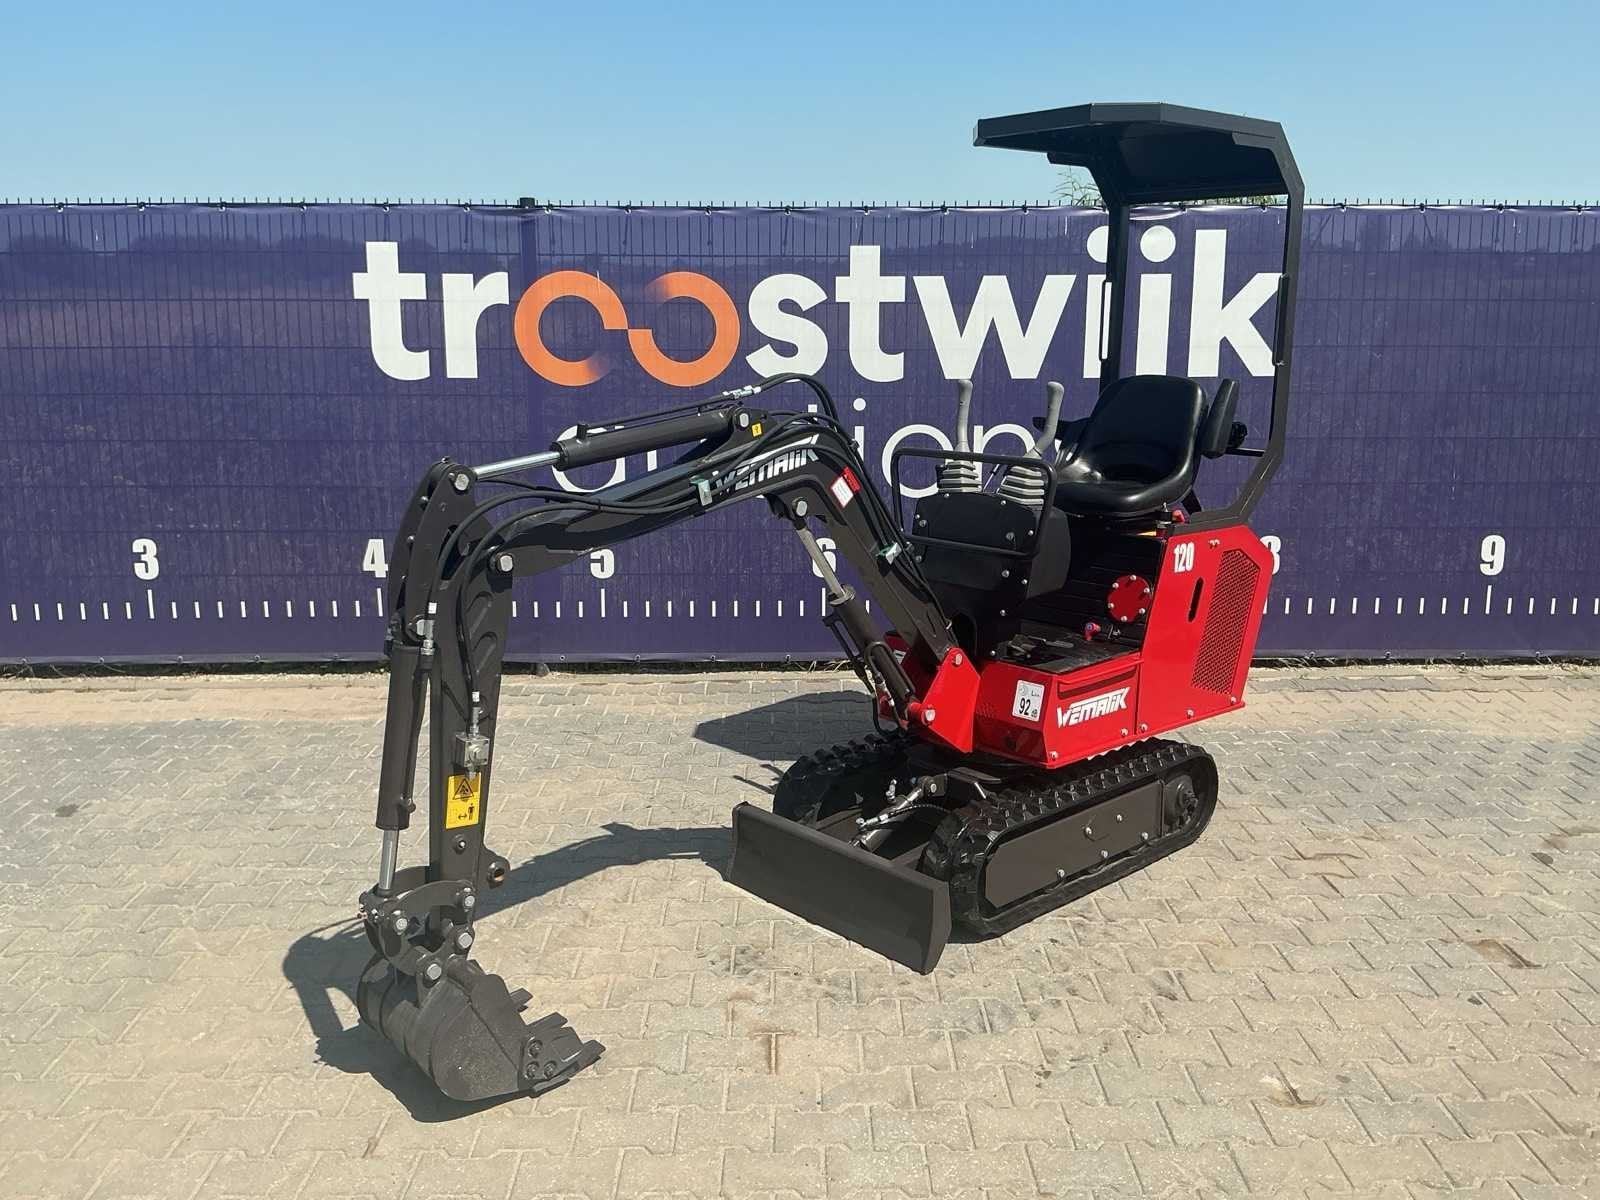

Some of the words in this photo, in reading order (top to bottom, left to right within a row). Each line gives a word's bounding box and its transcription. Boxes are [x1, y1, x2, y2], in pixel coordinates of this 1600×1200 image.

[352, 226, 1283, 387] troostwijk
[132, 537, 160, 581] 3
[362, 538, 389, 578] 4
[590, 548, 615, 579] 5
[1173, 542, 1195, 573] 120
[1479, 535, 1506, 576] 9
[1018, 697, 1031, 716] 92
